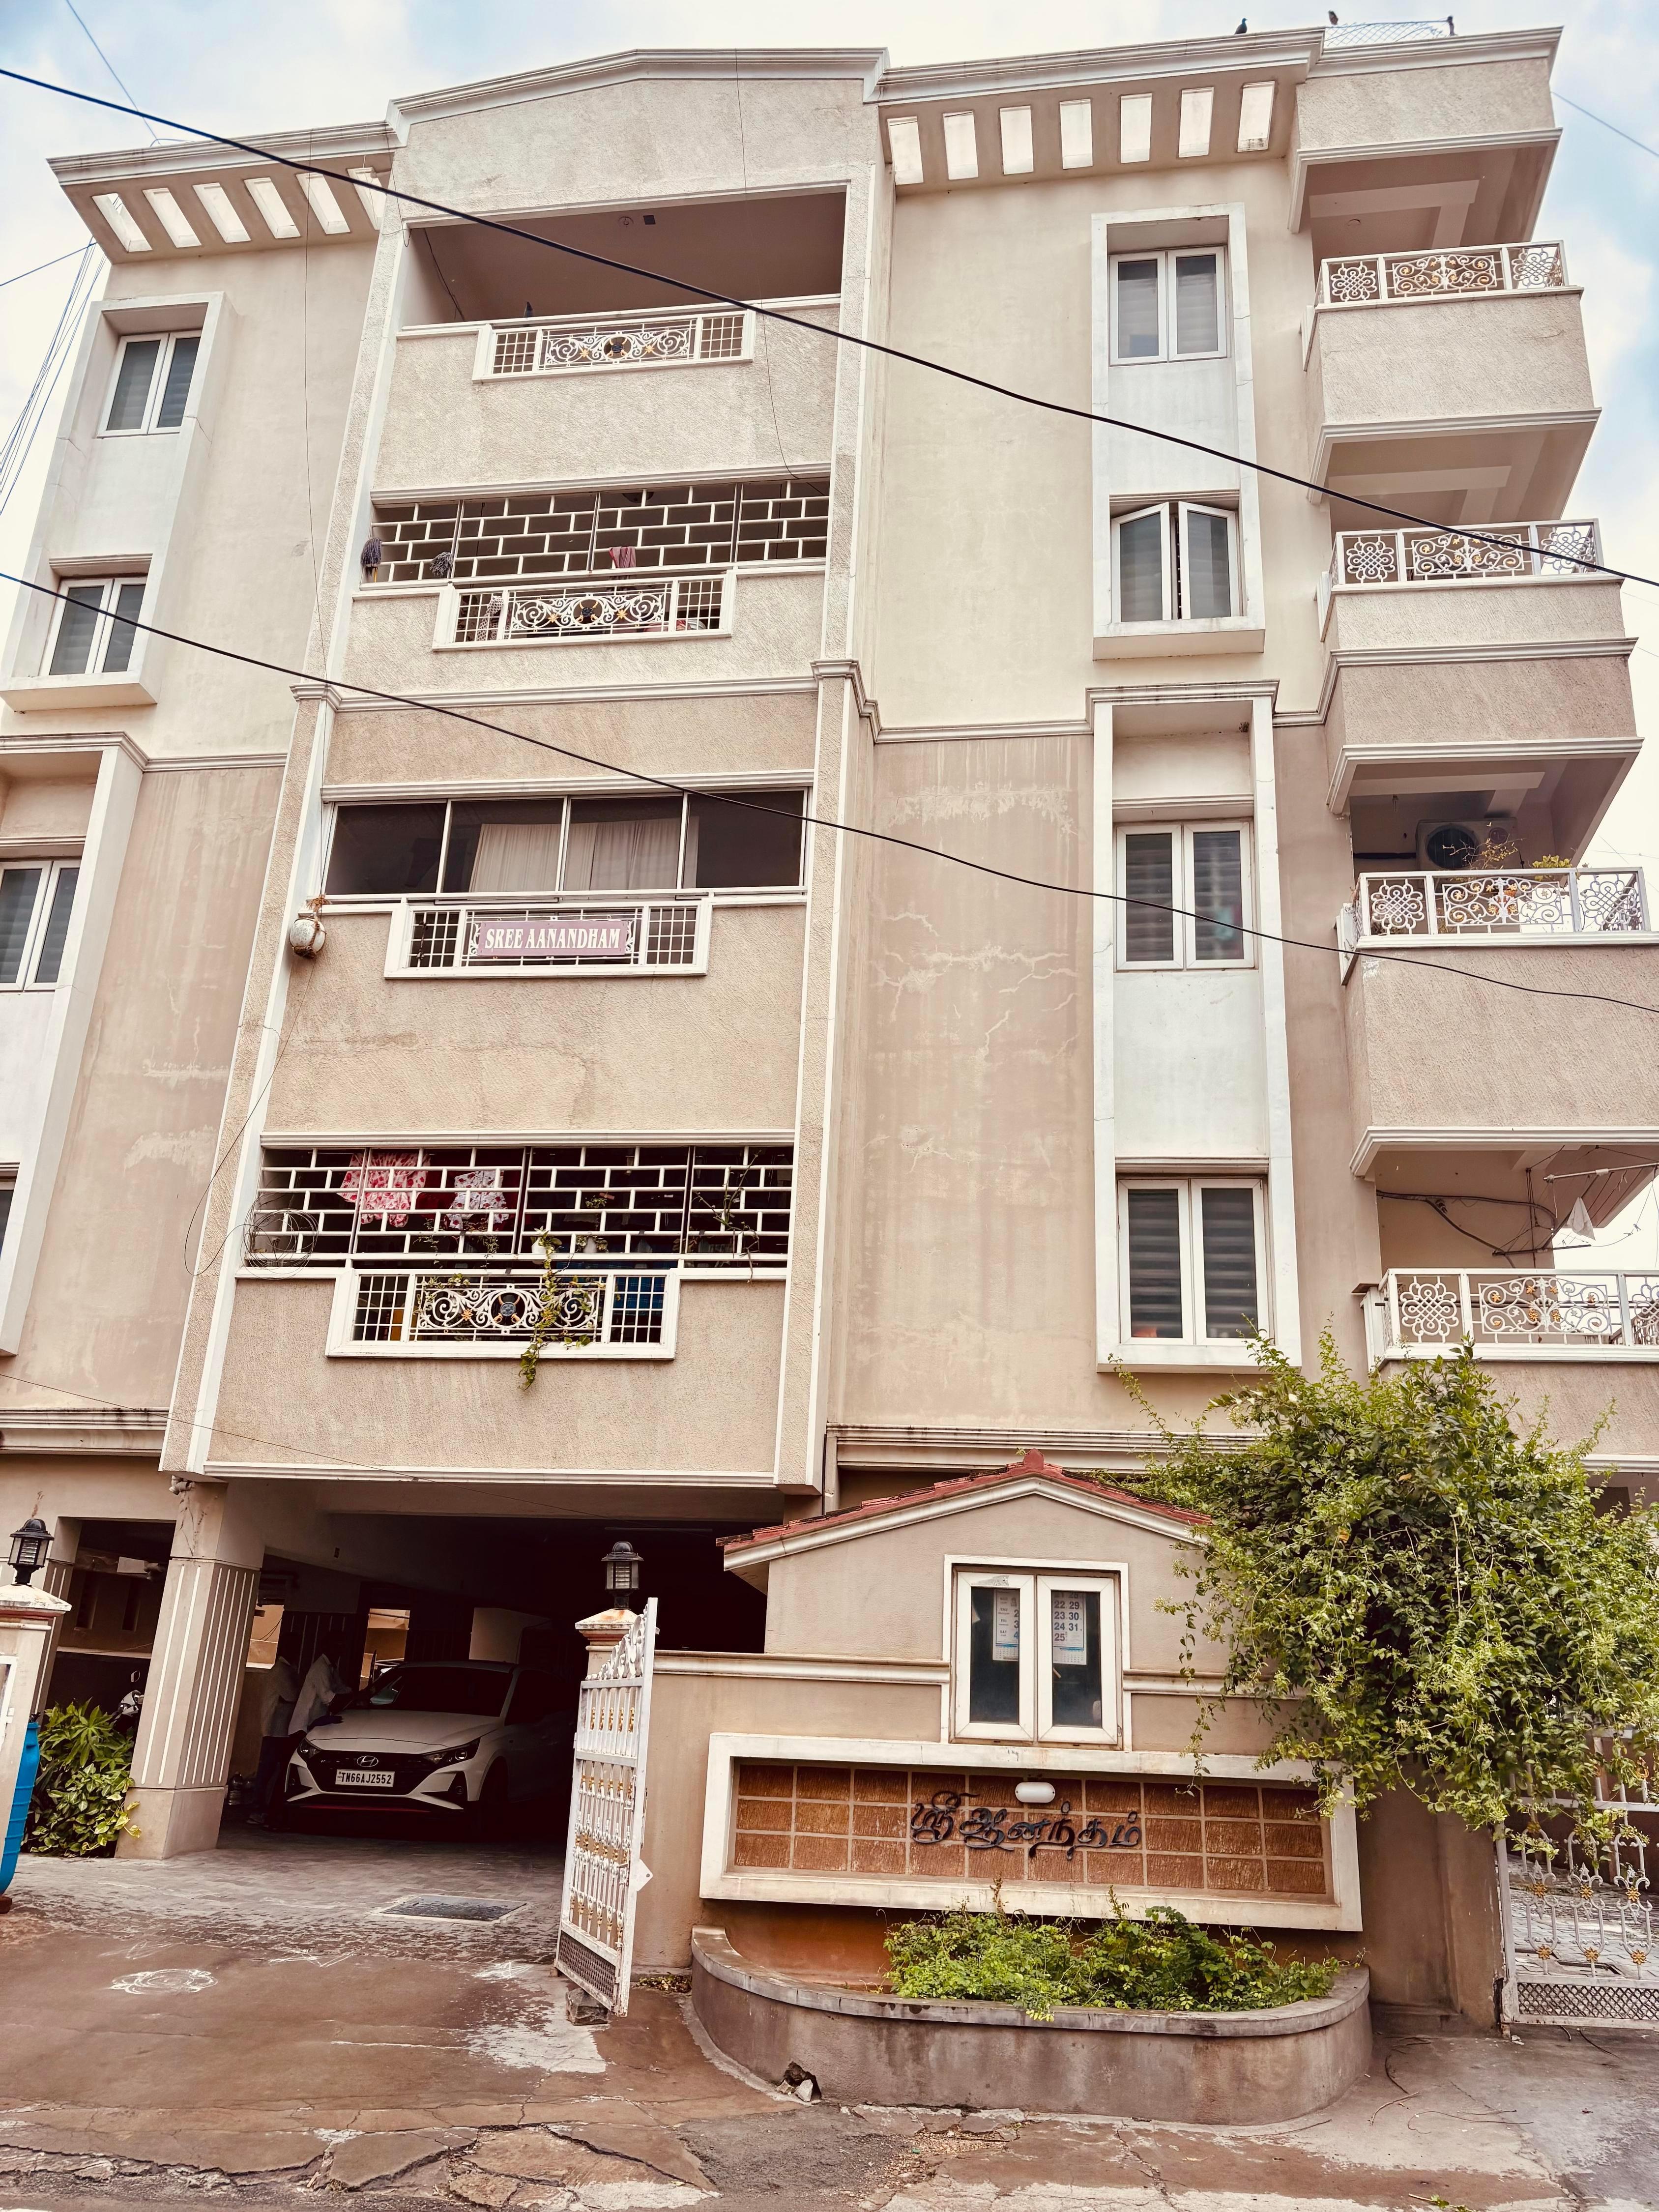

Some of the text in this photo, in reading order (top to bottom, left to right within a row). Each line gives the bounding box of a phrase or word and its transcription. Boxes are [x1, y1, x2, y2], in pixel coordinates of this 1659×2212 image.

[485, 928, 621, 949] SREE AANANDHAM
[1054, 1600, 1079, 1609] 22 29
[1069, 1623, 1078, 1631] 31
[1054, 1633, 1065, 1641] 25
[341, 1772, 392, 1784] TN66AJ2552
